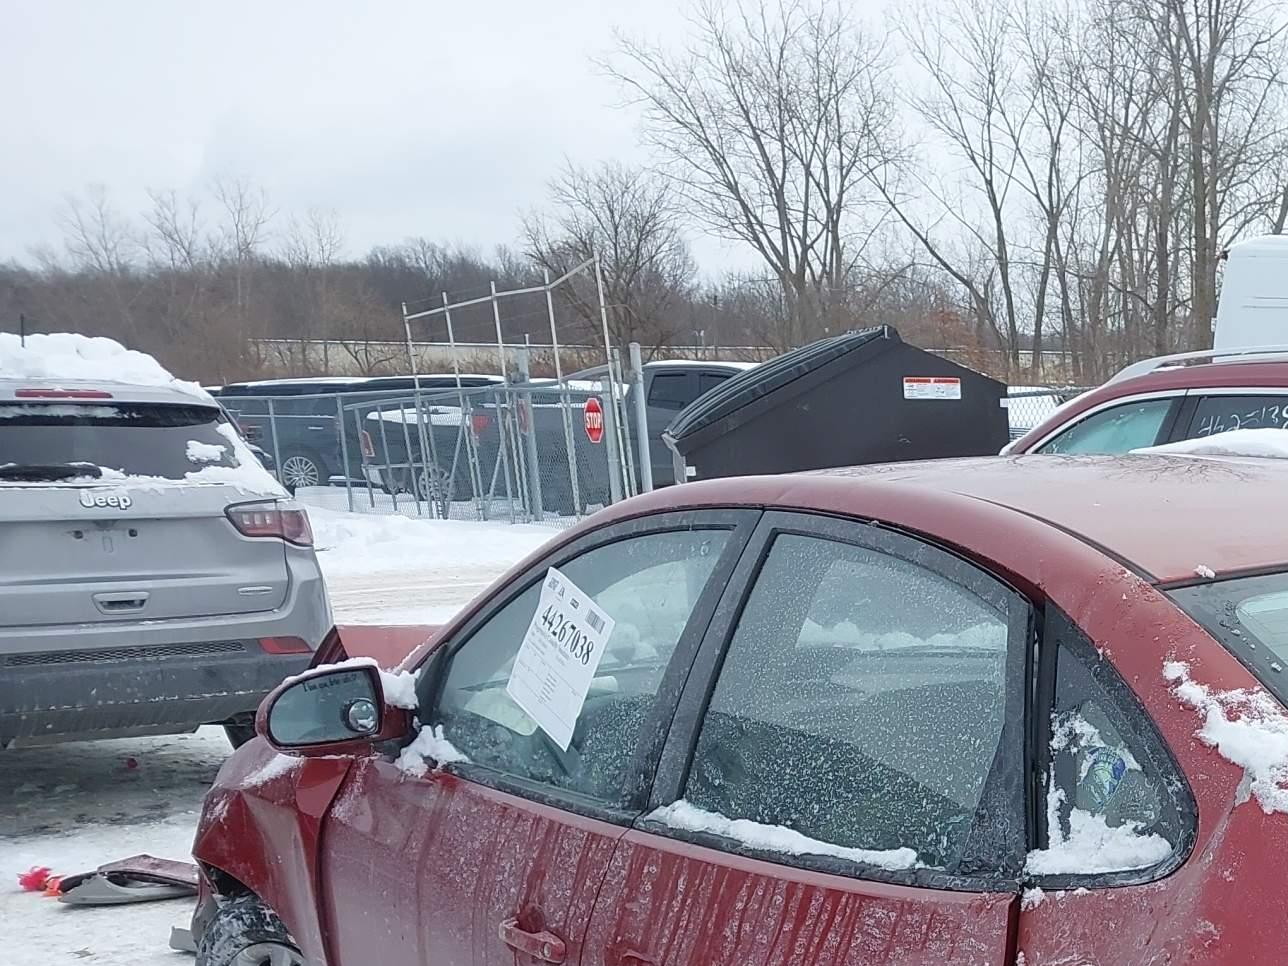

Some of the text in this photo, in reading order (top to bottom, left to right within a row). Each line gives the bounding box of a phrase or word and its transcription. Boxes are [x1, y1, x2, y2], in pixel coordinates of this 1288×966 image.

[585, 412, 601, 429] STOP
[80, 490, 132, 511] Jeep
[542, 605, 595, 666] 44267038
